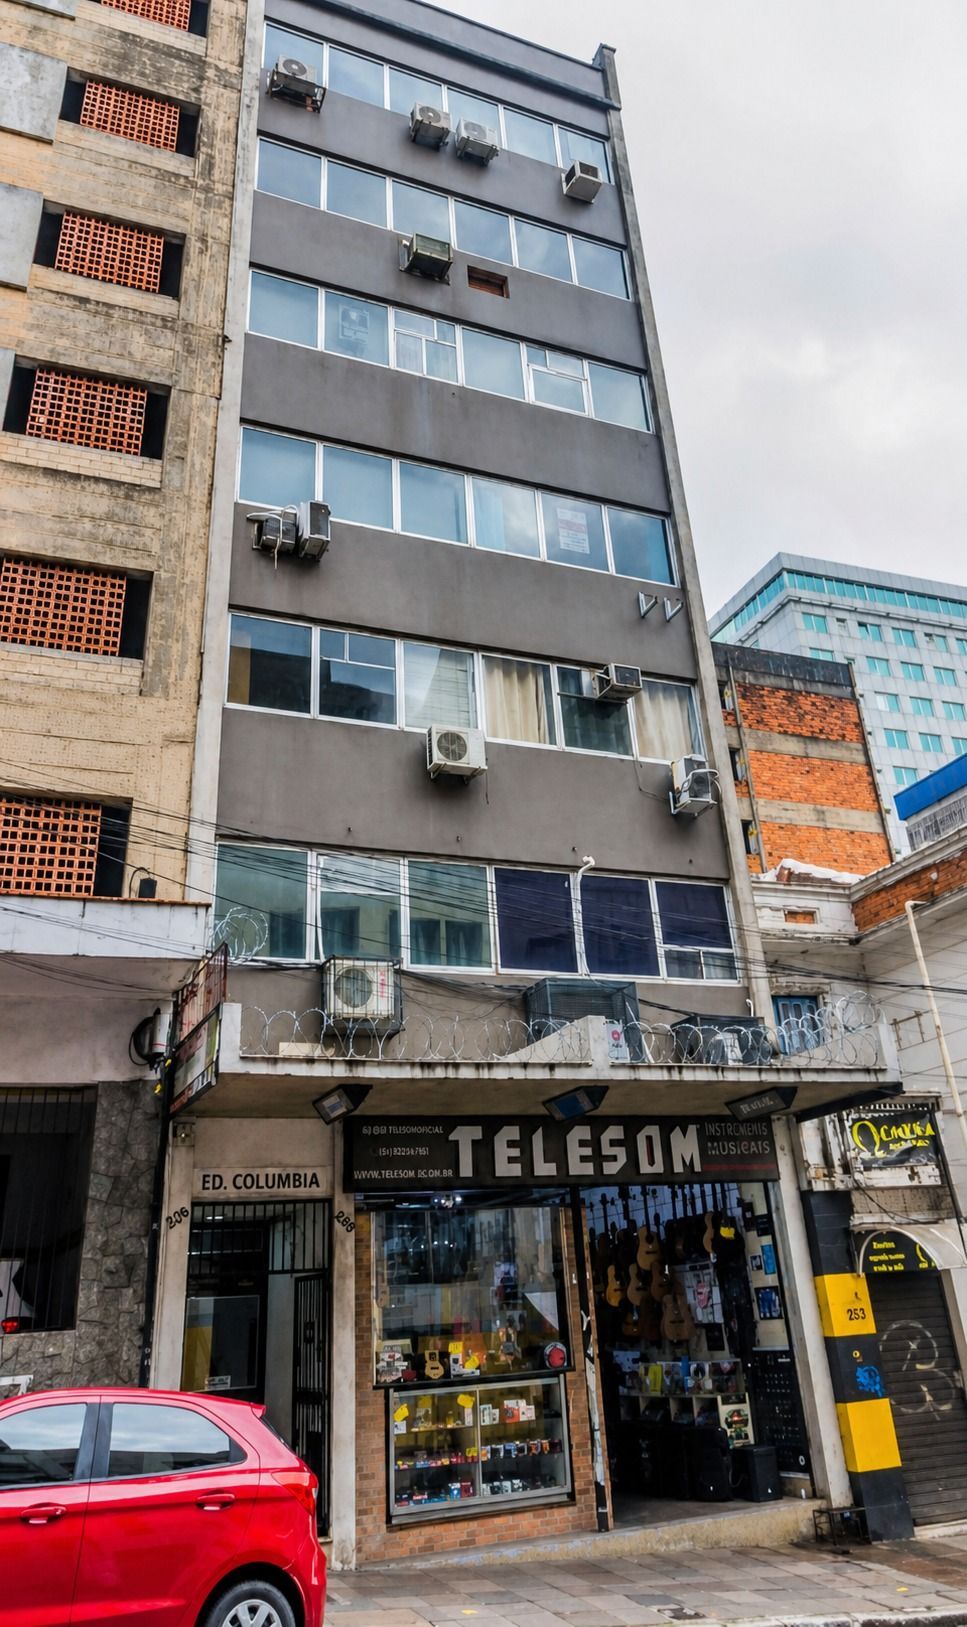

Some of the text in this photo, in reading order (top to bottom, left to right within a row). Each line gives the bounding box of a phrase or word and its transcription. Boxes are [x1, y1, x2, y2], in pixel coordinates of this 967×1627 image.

[448, 1124, 702, 1178] TELESOM
[202, 1172, 320, 1190] ED. COLUMBIA
[847, 1308, 866, 1321] 253
